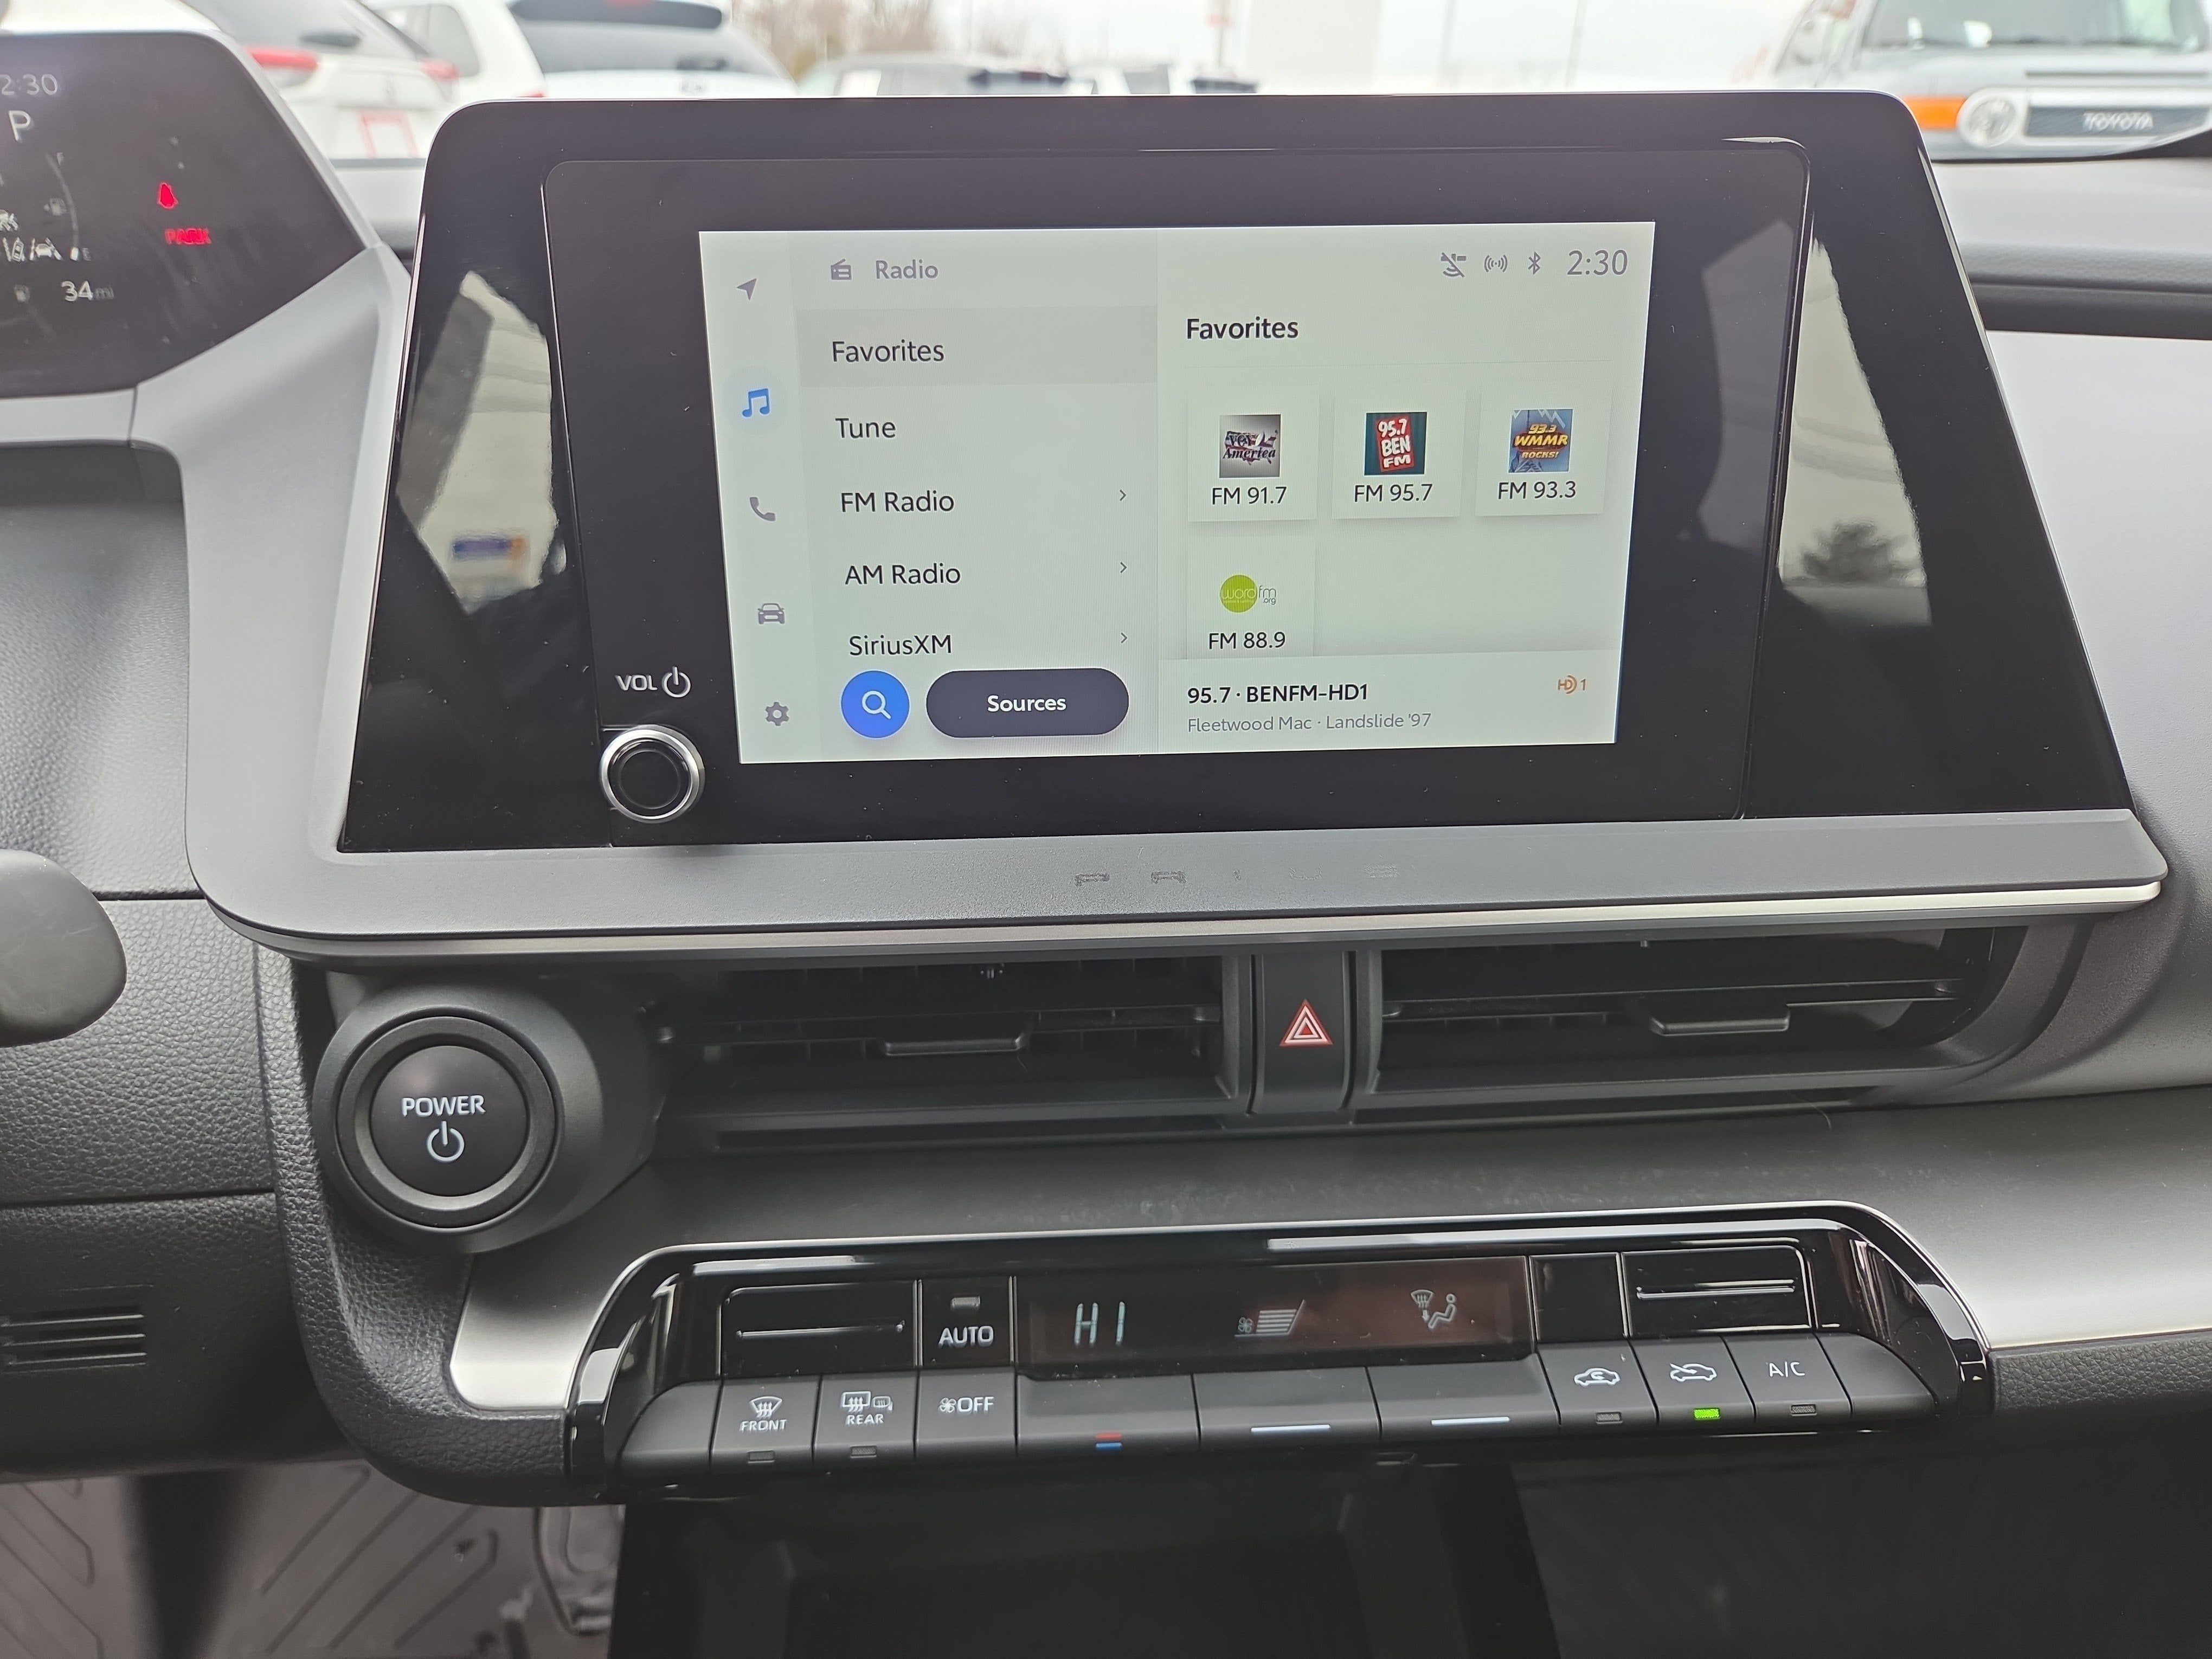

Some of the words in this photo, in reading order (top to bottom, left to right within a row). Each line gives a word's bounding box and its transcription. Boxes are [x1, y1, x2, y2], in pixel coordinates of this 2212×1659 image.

[9, 110, 31, 142] P
[2083, 112, 2154, 132] TOYOTA
[876, 259, 938, 279] Radio
[1567, 249, 1628, 275] 2:30
[1187, 316, 1298, 340] Favorites
[832, 339, 944, 363] Favorites
[835, 417, 896, 439] Tune
[1378, 418, 1408, 438] 95.7
[1528, 423, 1557, 434] 93.3
[1381, 435, 1411, 457] BEN
[1514, 434, 1568, 446] WMMR
[1383, 454, 1411, 468] FM
[1212, 487, 1240, 505] FM
[1248, 486, 1287, 504] 91.7
[1354, 484, 1382, 502] FM
[1390, 483, 1433, 501] 95.7
[1498, 481, 1527, 499] FM
[1534, 480, 1576, 499] 93.3
[841, 492, 876, 512] FM
[884, 490, 954, 512] Radio
[845, 565, 883, 585] AM
[892, 562, 961, 584] Radio
[850, 634, 951, 656] SiriusXM
[1209, 633, 1237, 650] FM
[1243, 632, 1285, 649] 88.9
[615, 674, 658, 692] VOL
[987, 695, 1066, 712] Sources
[1187, 687, 1231, 704] 95.7
[1247, 684, 1367, 703] BENFM-HD1
[1188, 716, 1274, 732] Fleetwood
[1279, 716, 1312, 731] Mac
[1326, 713, 1404, 729] Landslide
[1408, 713, 1431, 728] '97
[402, 1095, 486, 1117] POWER
[938, 1326, 994, 1346] AUTO
[1769, 1361, 1806, 1378] A/C
[957, 1396, 995, 1413] OFF
[740, 1420, 787, 1432] FRONT
[845, 1413, 884, 1425] REAR
